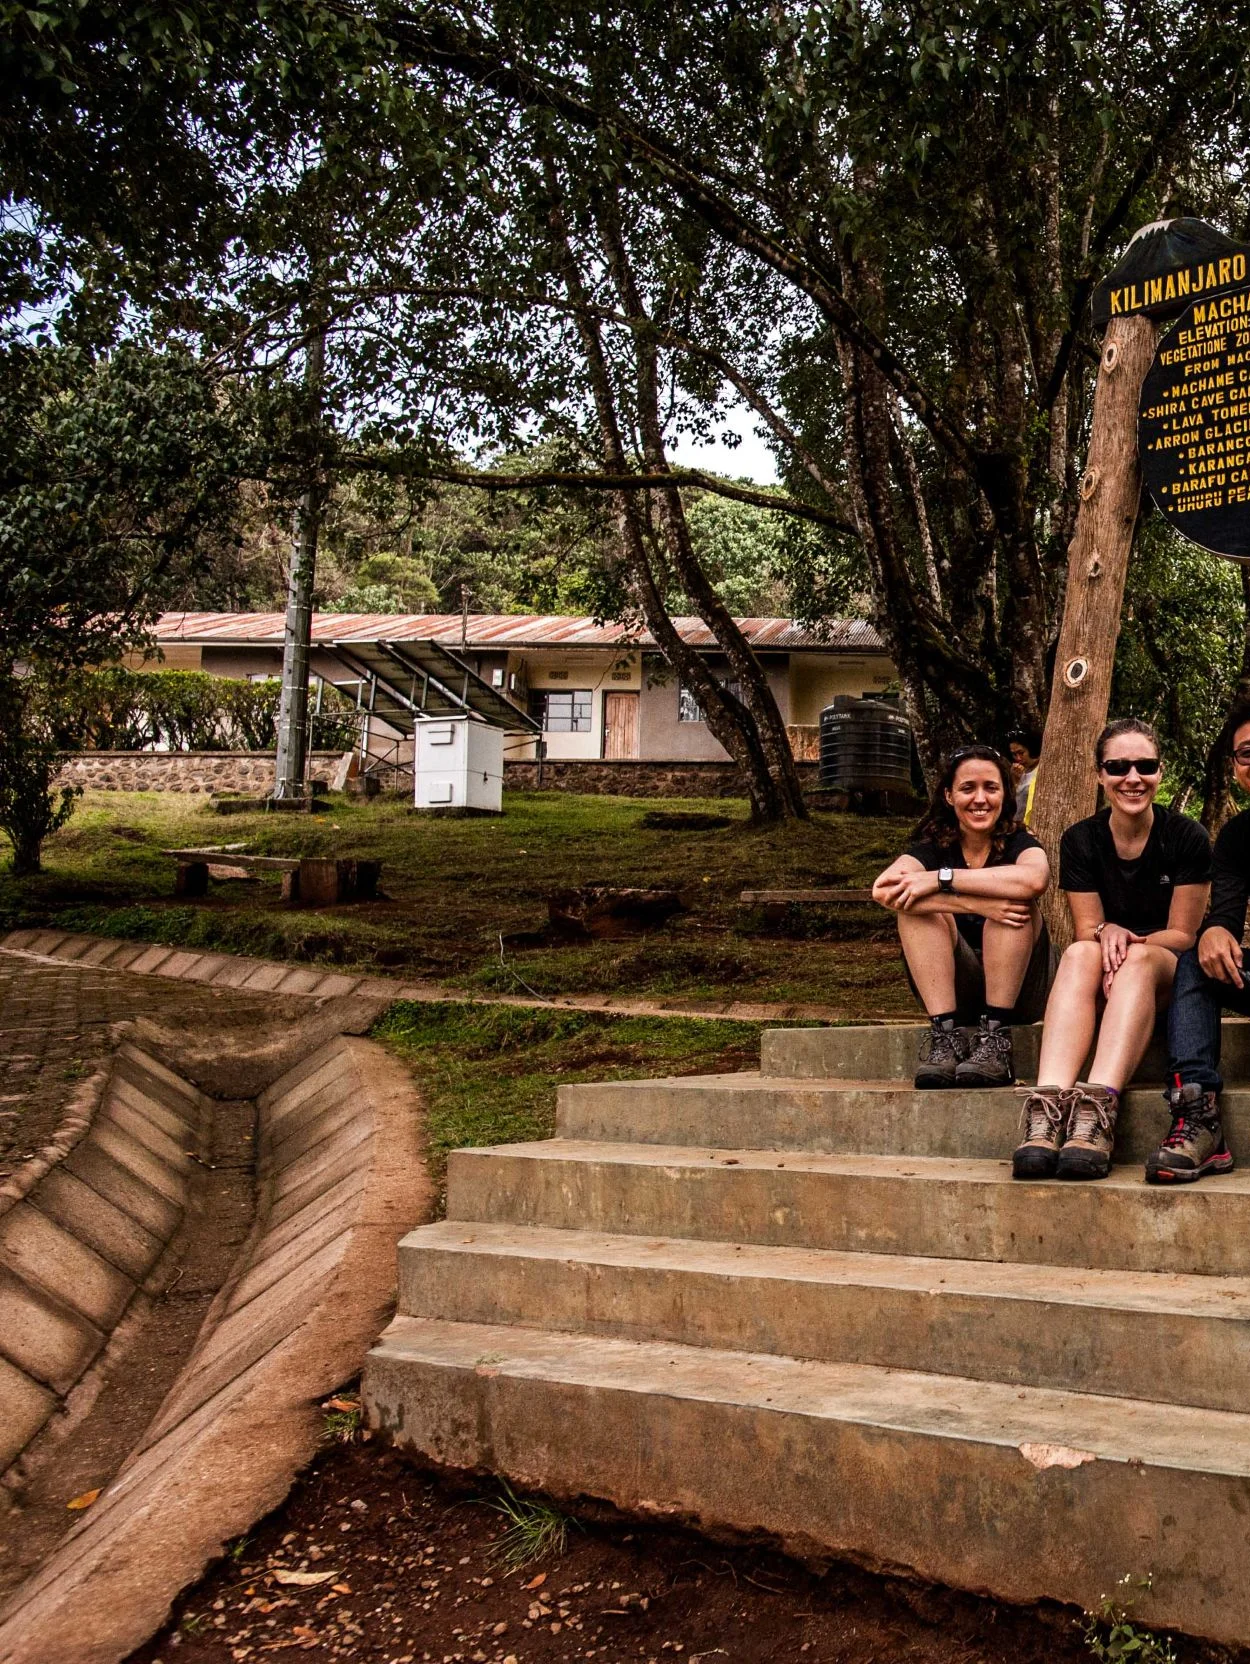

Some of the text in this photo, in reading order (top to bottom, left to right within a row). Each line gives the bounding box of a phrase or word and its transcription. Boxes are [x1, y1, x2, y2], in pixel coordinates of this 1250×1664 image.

[1110, 254, 1246, 315] KILIMANJARO
[1160, 337, 1227, 366] VEGETATIONE
[1184, 358, 1220, 377] FROM
[1171, 371, 1234, 398] MACHAME
[1148, 400, 1186, 419] SHIRA
[1191, 392, 1225, 409] CAVE
[1172, 413, 1204, 430] LAVA
[1155, 430, 1200, 451] ARROW
[1172, 473, 1226, 495] BARAFU
[1177, 491, 1222, 513] UHURU
